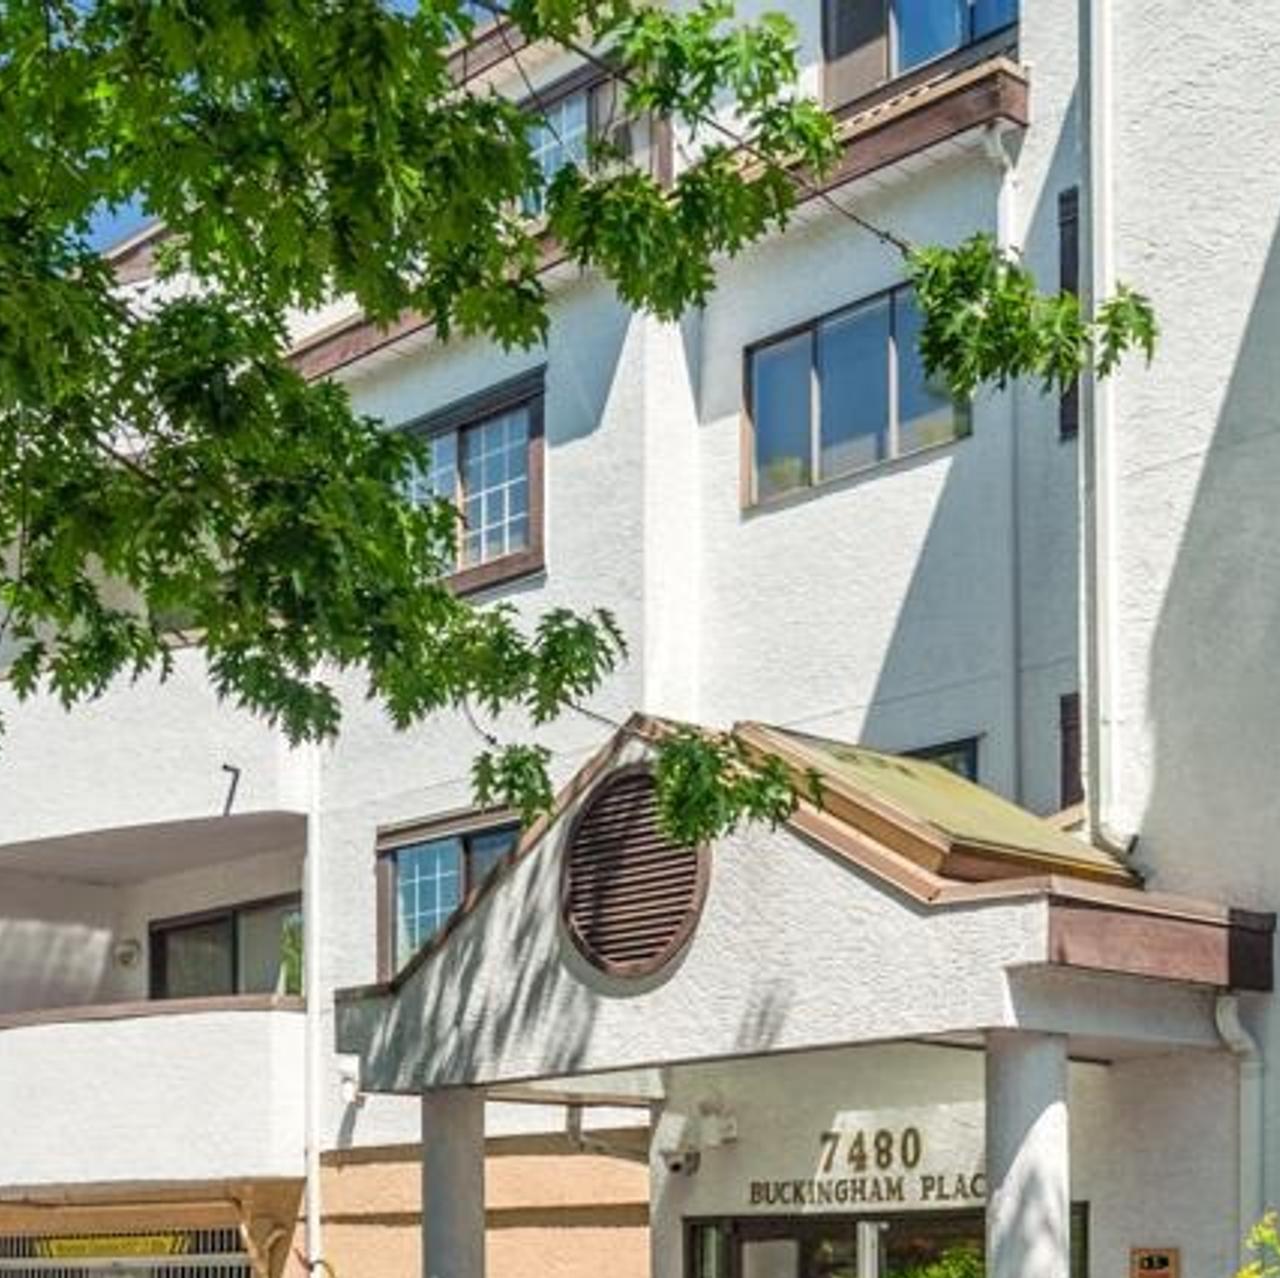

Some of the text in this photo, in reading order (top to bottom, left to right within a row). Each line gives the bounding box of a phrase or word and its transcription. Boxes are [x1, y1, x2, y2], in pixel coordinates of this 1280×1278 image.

[821, 1127, 921, 1172] 7480
[750, 1173, 986, 1205] BUCKINGHAM PLAC
